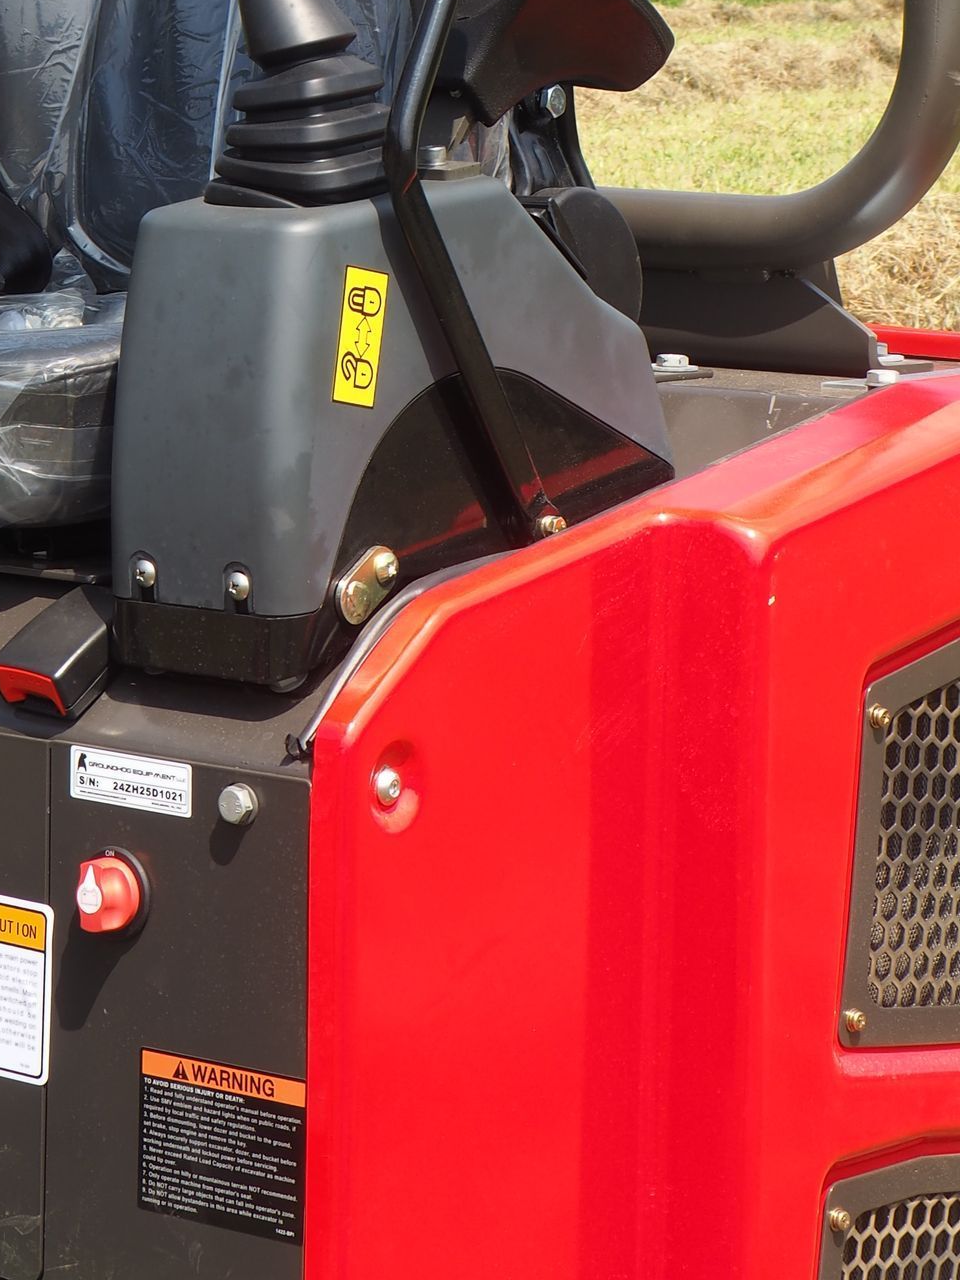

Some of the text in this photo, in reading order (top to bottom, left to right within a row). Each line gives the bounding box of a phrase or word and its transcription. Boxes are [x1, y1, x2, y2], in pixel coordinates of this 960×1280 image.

[88, 761, 132, 774] GROUNDHOG
[132, 768, 176, 781] EQUIPMENT
[79, 775, 99, 788] S/N:
[113, 781, 183, 802] 24ZH25D1021
[152, 1079, 169, 1088] AVOID
[170, 1083, 193, 1093] SERIOUS
[195, 1088, 214, 1097] INJURY
[225, 1094, 245, 1104] DEATH:
[192, 1063, 275, 1098] WARNING
[150, 1087, 163, 1095] Read
[174, 1093, 185, 1101] fully
[186, 1096, 213, 1106] understand
[215, 1102, 239, 1111] operator's
[260, 1111, 276, 1119] before
[173, 1102, 192, 1110] emblem
[204, 1107, 221, 1116] hazard
[222, 1111, 235, 1119] lights
[150, 1113, 166, 1121] Before
[199, 1123, 213, 1131] lower
[213, 1126, 227, 1135] dozer
[239, 1132, 256, 1141] bucket
[172, 1109, 184, 1117] local
[185, 1112, 199, 1120] traffic
[211, 1119, 226, 1127] safety
[169, 1126, 179, 1134] stop
[208, 1135, 227, 1143] remove
[143, 1138, 162, 1147] working
[163, 1143, 190, 1152] underneath
[202, 1150, 220, 1159] lockout
[237, 1158, 253, 1166] before
[149, 1130, 166, 1139] Always
[167, 1135, 188, 1144] securely
[262, 1155, 279, 1163] bucket
[280, 1158, 297, 1167] before
[149, 1146, 164, 1155] Never
[164, 1151, 182, 1159] exceed
[183, 1154, 197, 1162] Rated
[199, 1157, 211, 1165] Load
[212, 1160, 234, 1172] Capacity
[241, 1168, 266, 1177] excavator
[274, 1175, 295, 1184] machine
[149, 1163, 172, 1173] Operation
[231, 1182, 247, 1190] terrain
[148, 1172, 159, 1181] Only
[161, 1176, 179, 1184] operate
[181, 1180, 201, 1188] machine
[215, 1188, 239, 1197] operator's
[142, 1197, 160, 1206] running
[168, 1186, 181, 1194] carry
[182, 1188, 194, 1196] large
[196, 1192, 213, 1200] objects
[256, 1206, 280, 1215] operator's
[182, 1197, 209, 1207] bystanders
[253, 1214, 277, 1223] excavator
